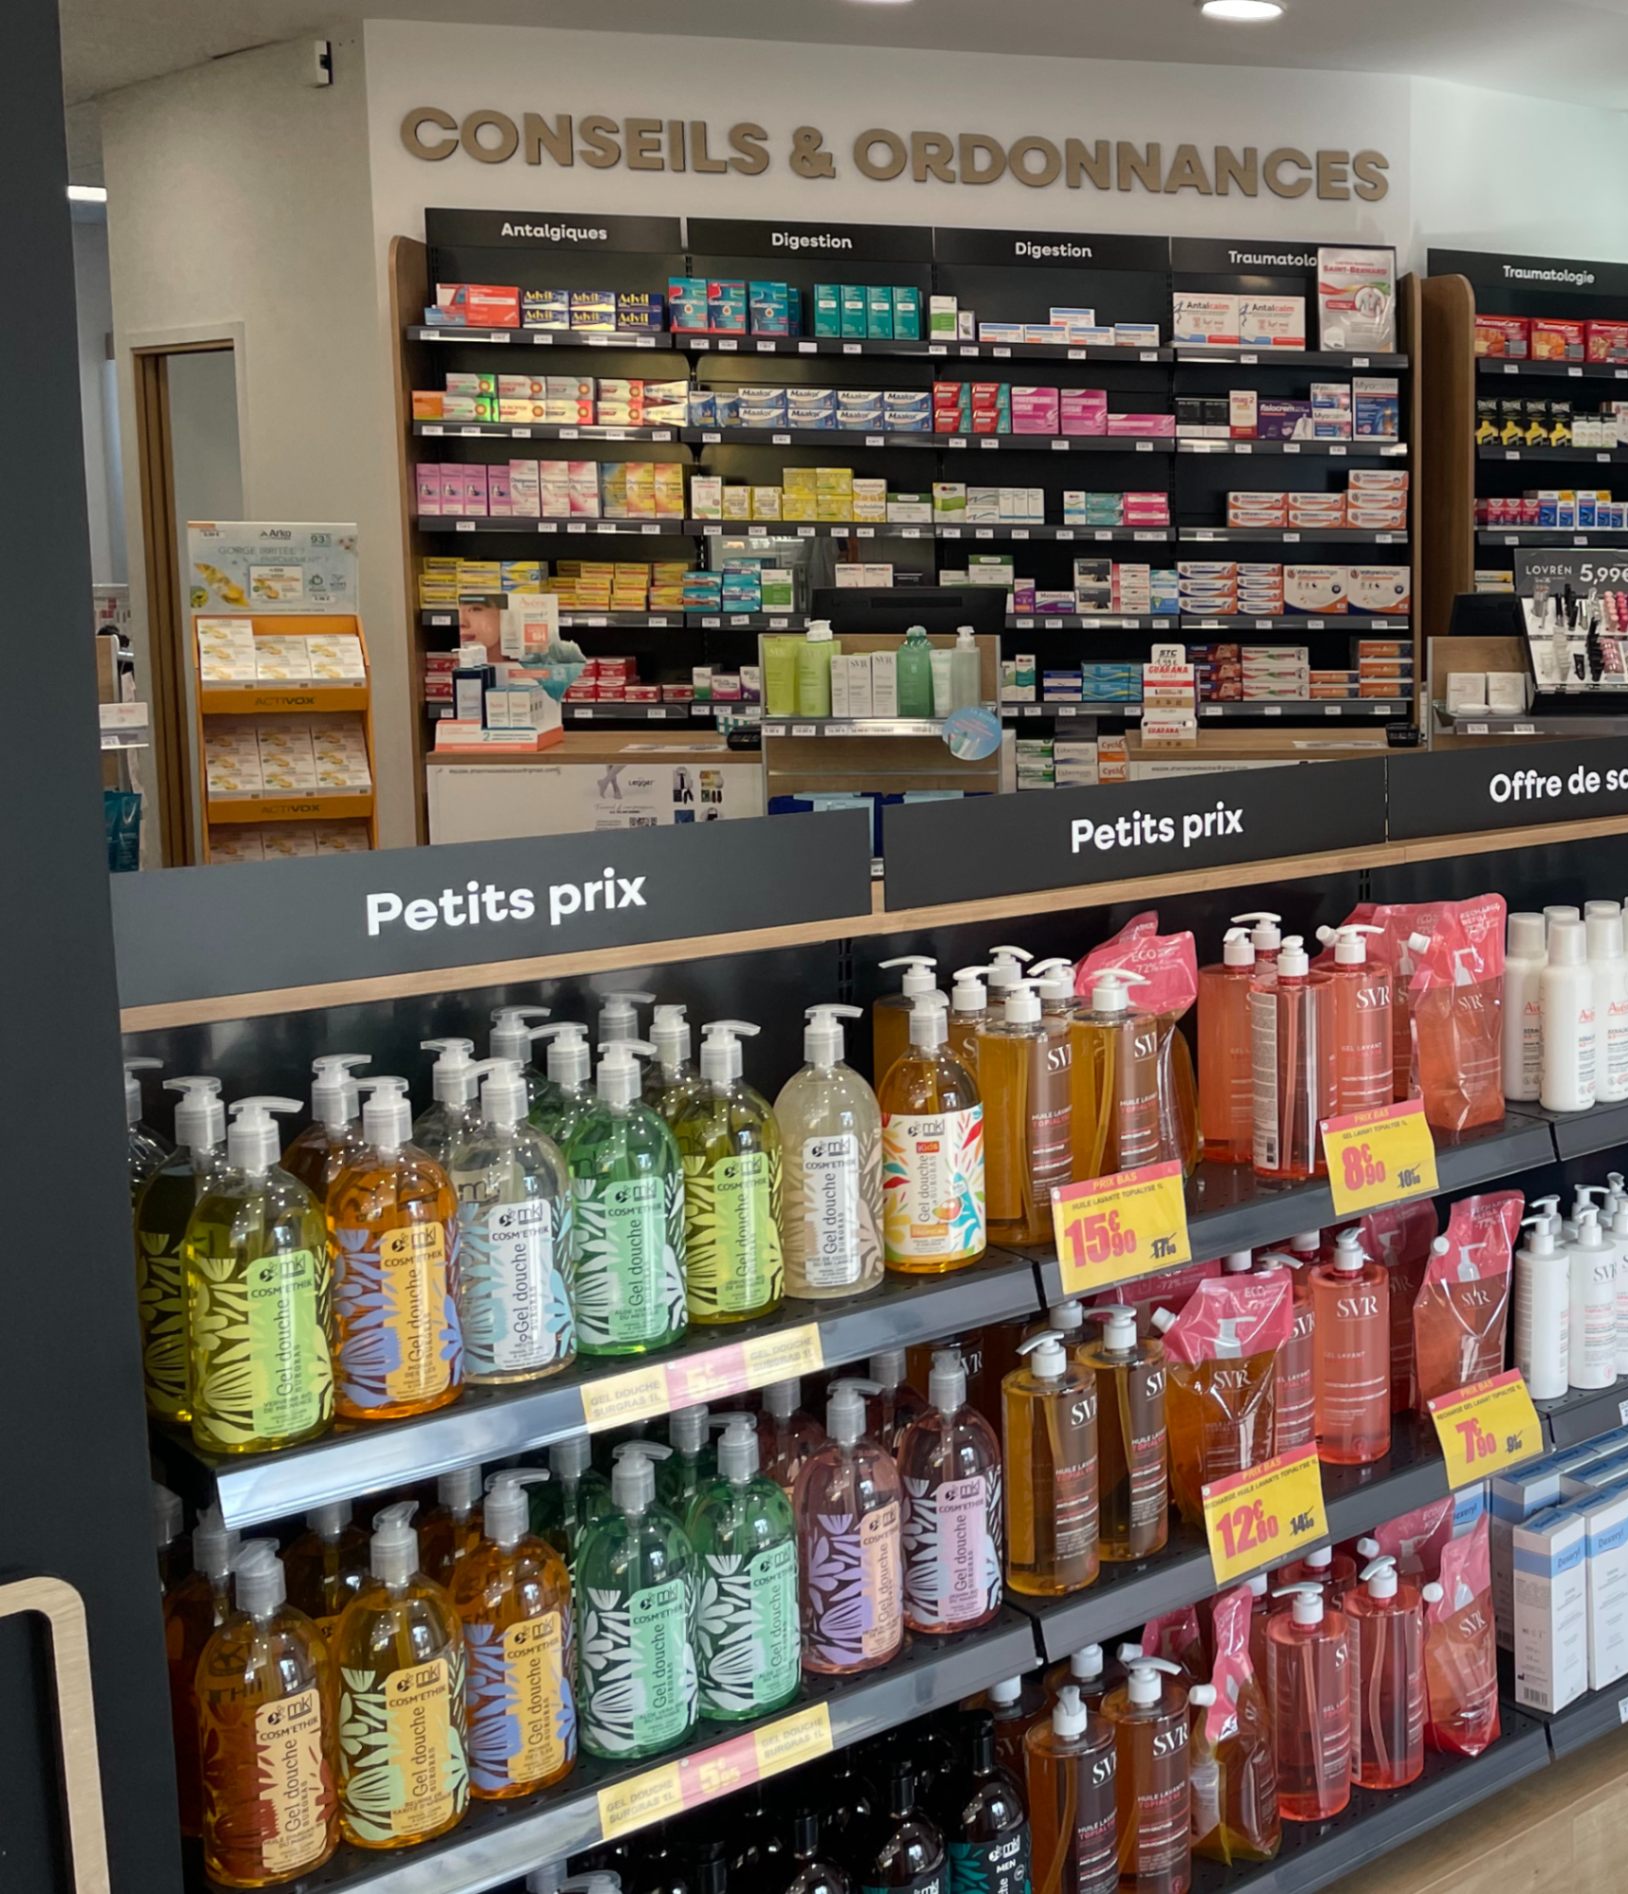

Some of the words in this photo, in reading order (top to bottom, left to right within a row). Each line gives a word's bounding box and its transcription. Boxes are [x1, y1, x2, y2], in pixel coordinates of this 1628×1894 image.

[401, 106, 770, 176] CONSEILS
[790, 125, 836, 179] &
[852, 127, 1390, 202] ORDONNANCES
[501, 222, 607, 243] Antalgiques
[771, 232, 853, 252] Digestion
[1015, 241, 1093, 260] Digestion
[1229, 250, 1317, 268] Traumatolo
[1503, 264, 1596, 285] Traumatologie
[619, 294, 649, 305] Advil
[619, 312, 649, 323] Advil
[1490, 771, 1562, 803] Offre
[1568, 765, 1601, 794] de
[1072, 808, 1175, 853] Petits
[1183, 802, 1244, 847] prix
[367, 881, 536, 936] Petits
[549, 867, 648, 926] prix
[1132, 948, 1157, 963] ECO
[1357, 984, 1391, 1010] SVR
[1458, 992, 1483, 1012] SVR
[923, 1119, 945, 1137] mkl
[917, 1155, 930, 1198] douche
[1093, 1178, 1114, 1191] PRIX
[1116, 1171, 1137, 1184] BAS
[519, 1203, 543, 1224] mkl
[823, 1173, 837, 1227] douche
[919, 1200, 930, 1223] Gel
[628, 1219, 641, 1280] douche
[824, 1229, 837, 1255] Gel
[1065, 1209, 1137, 1268] 15€90
[514, 1243, 526, 1302] douche
[405, 1270, 422, 1329] douche
[629, 1281, 642, 1307] Gel
[1336, 1295, 1378, 1318] SVR
[275, 1297, 293, 1358] douche
[514, 1303, 528, 1332] Gel
[407, 1331, 422, 1366] Gel
[276, 1359, 293, 1396] Gel
[1214, 1366, 1252, 1390] SVR
[956, 1514, 968, 1570] douche
[1557, 1547, 1583, 1569] Dexeryl
[956, 1571, 968, 1591] Gel
[653, 1622, 665, 1678] douche
[415, 1663, 441, 1688] mkl
[528, 1657, 541, 1711] douche
[653, 1680, 667, 1710] Gel
[413, 1705, 428, 1767] douche
[528, 1713, 541, 1744] Gel
[1153, 1721, 1189, 1758] SVR
[285, 1738, 298, 1793] douche
[414, 1767, 428, 1800] Gel
[630, 1779, 674, 1803] DOUCHE
[285, 1794, 298, 1832] Gel
[609, 1799, 661, 1826] SURGRAS
[996, 1858, 1017, 1874] MEN
